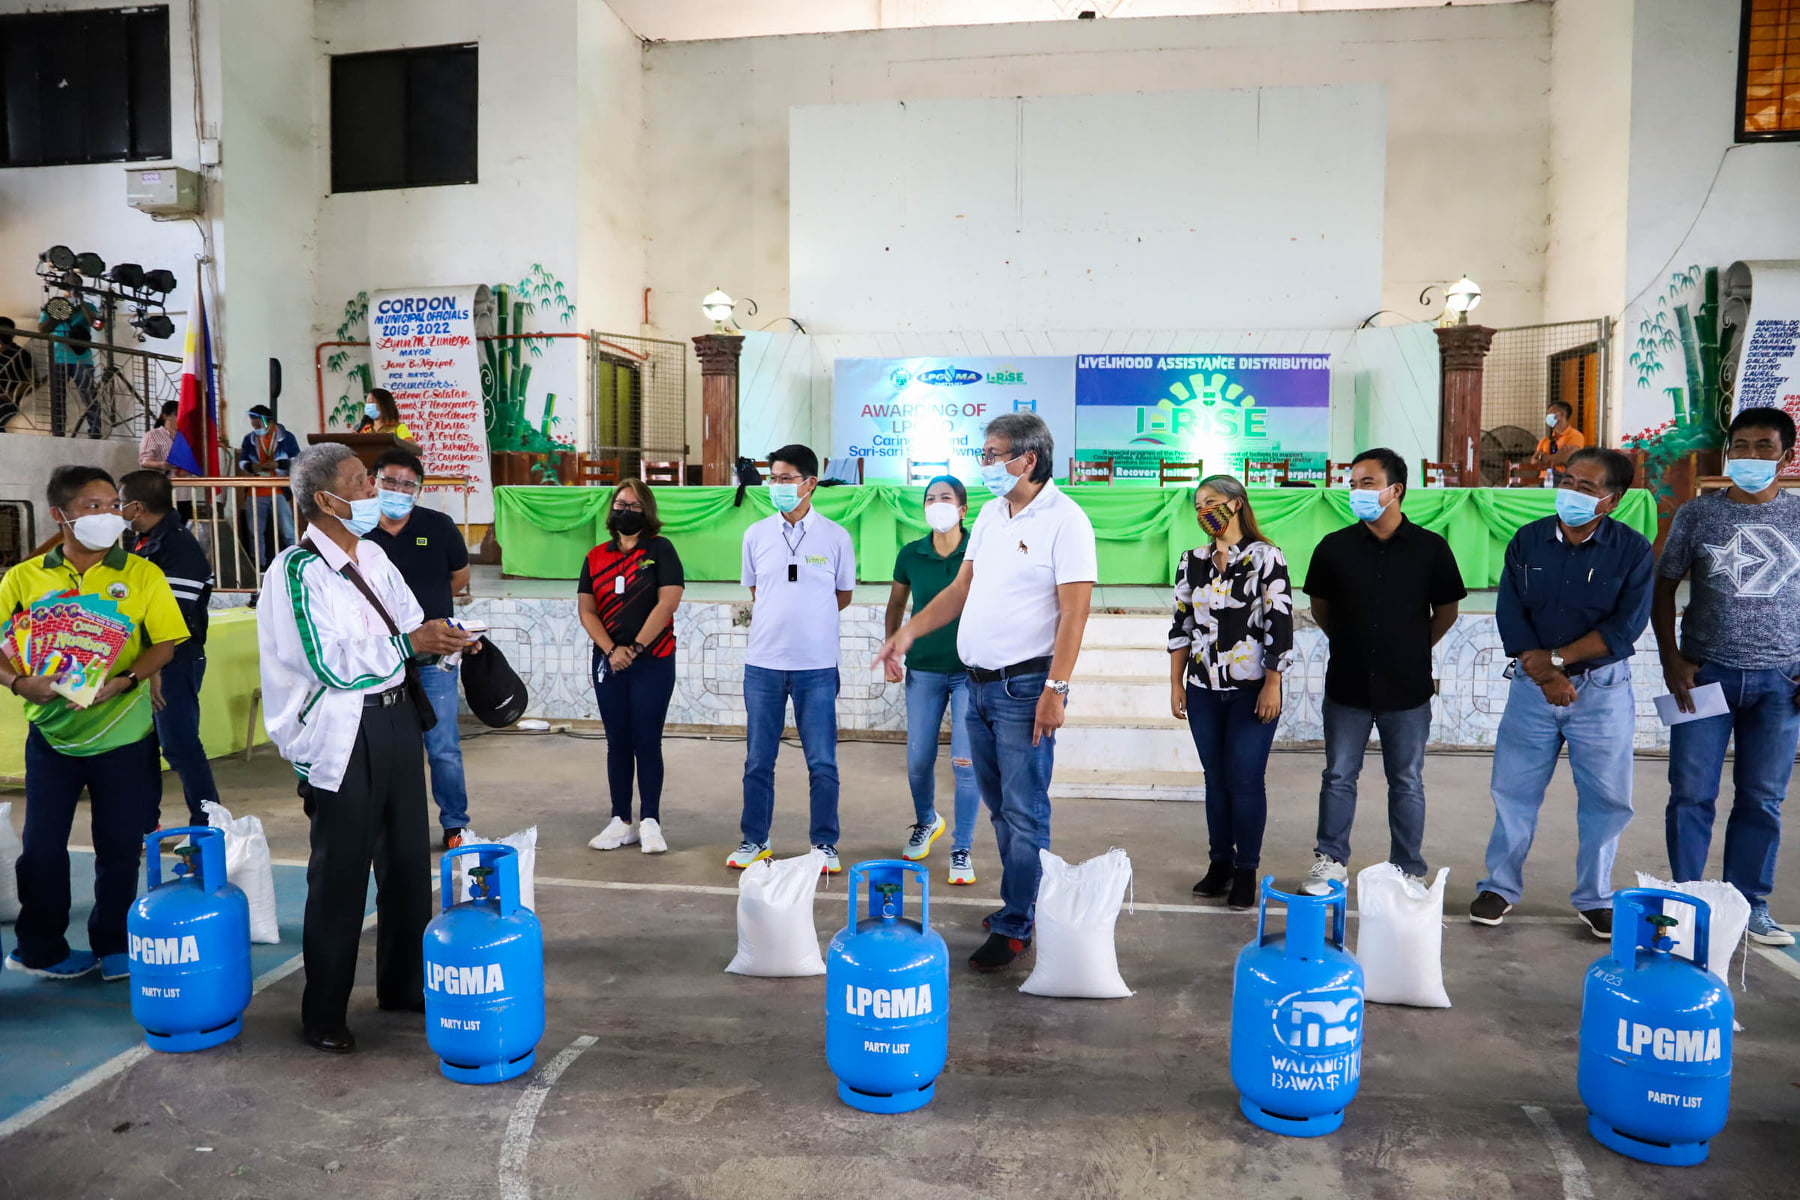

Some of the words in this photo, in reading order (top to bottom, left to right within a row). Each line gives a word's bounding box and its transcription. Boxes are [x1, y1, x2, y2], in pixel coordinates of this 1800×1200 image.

[378, 296, 456, 314] CORDON
[374, 312, 425, 325] MUNICIPAL
[426, 310, 469, 322] OFFICIALS
[399, 349, 431, 357] MAYOR
[1078, 356, 1153, 369] LIVELIHOOD
[1156, 356, 1235, 371] ASSISTANCE
[1239, 357, 1331, 370] DISTRIBUTION
[861, 404, 958, 417] AWARDING
[962, 403, 987, 417] OF
[849, 446, 903, 457] Sari-sari
[1116, 467, 1160, 478] Recovery
[128, 931, 200, 966] LPGMA
[427, 960, 505, 996] LPGMA
[141, 985, 162, 999] PARTY
[164, 987, 180, 999] LIST
[846, 983, 933, 1019] LPGMA
[440, 1017, 462, 1030] PARTY
[463, 1019, 480, 1031] LIST
[864, 1040, 890, 1053] PARTY
[892, 1043, 910, 1054] LIST
[1617, 1018, 1721, 1062] LPGMA
[1272, 1055, 1343, 1074] WALANG
[1648, 1090, 1680, 1107] PARTY
[1682, 1096, 1702, 1108] LIST
